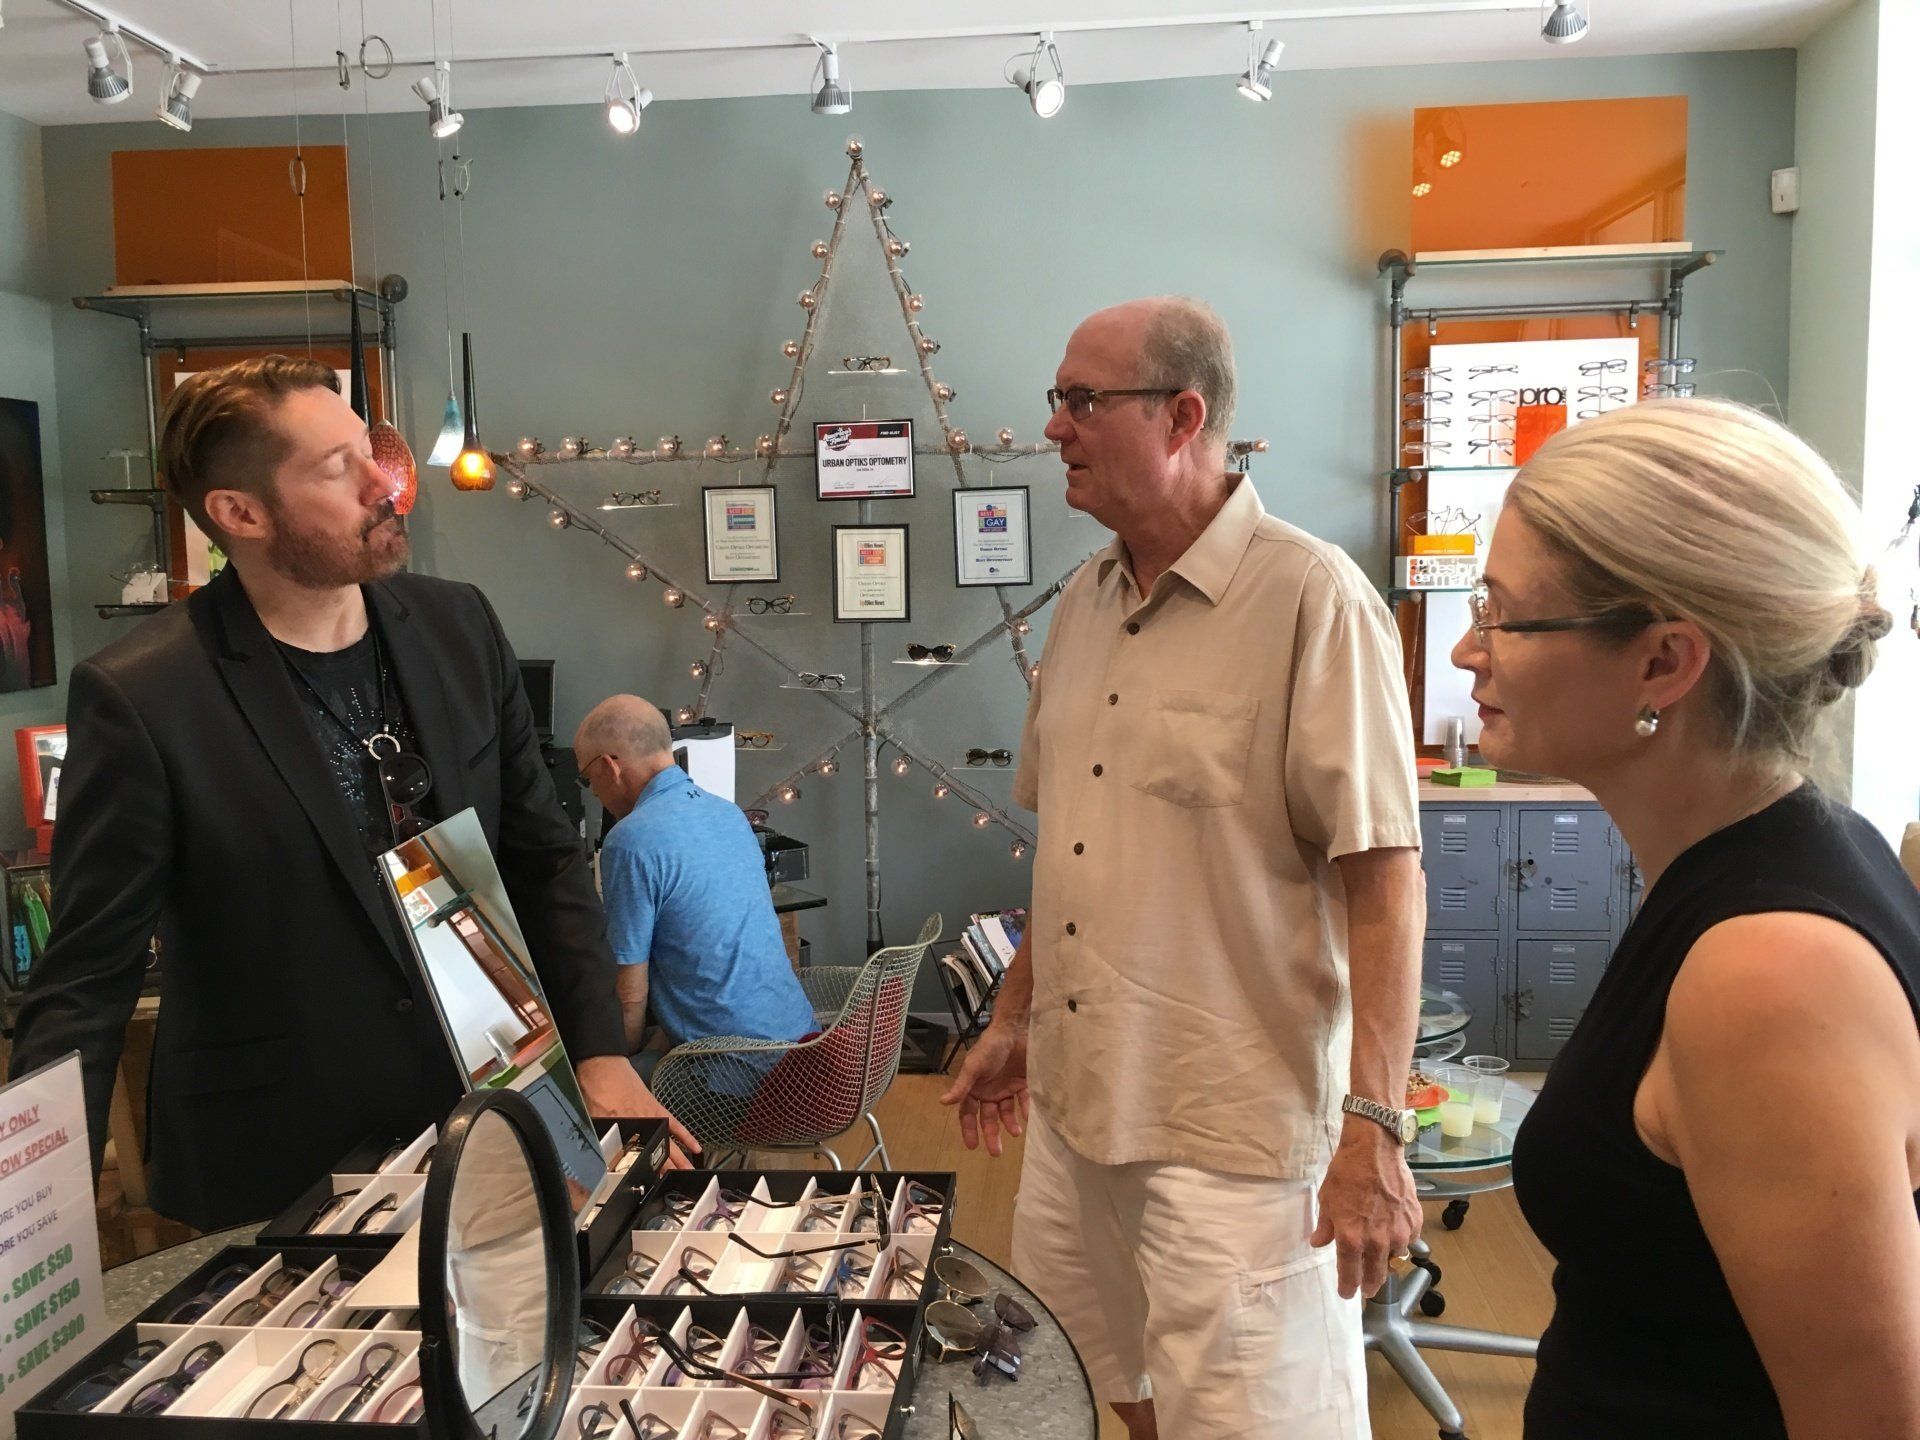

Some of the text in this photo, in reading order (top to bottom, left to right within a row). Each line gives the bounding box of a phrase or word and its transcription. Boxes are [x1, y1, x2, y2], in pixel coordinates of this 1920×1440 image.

[1519, 387, 1563, 408] pro
[822, 456, 907, 468] URBAN OPTIKS OPTOMETRY
[986, 518, 1005, 527] GAY
[9, 1103, 39, 1132] ONLY
[25, 1126, 69, 1161] SPECIAL
[15, 1194, 35, 1214] YOU
[36, 1183, 53, 1203] BUY
[16, 1222, 36, 1243] YOU
[37, 1208, 59, 1231] SAVE
[12, 1243, 73, 1300] SAVE $50
[14, 1277, 81, 1340] SAVE $150
[17, 1313, 85, 1379] SAVE $300
